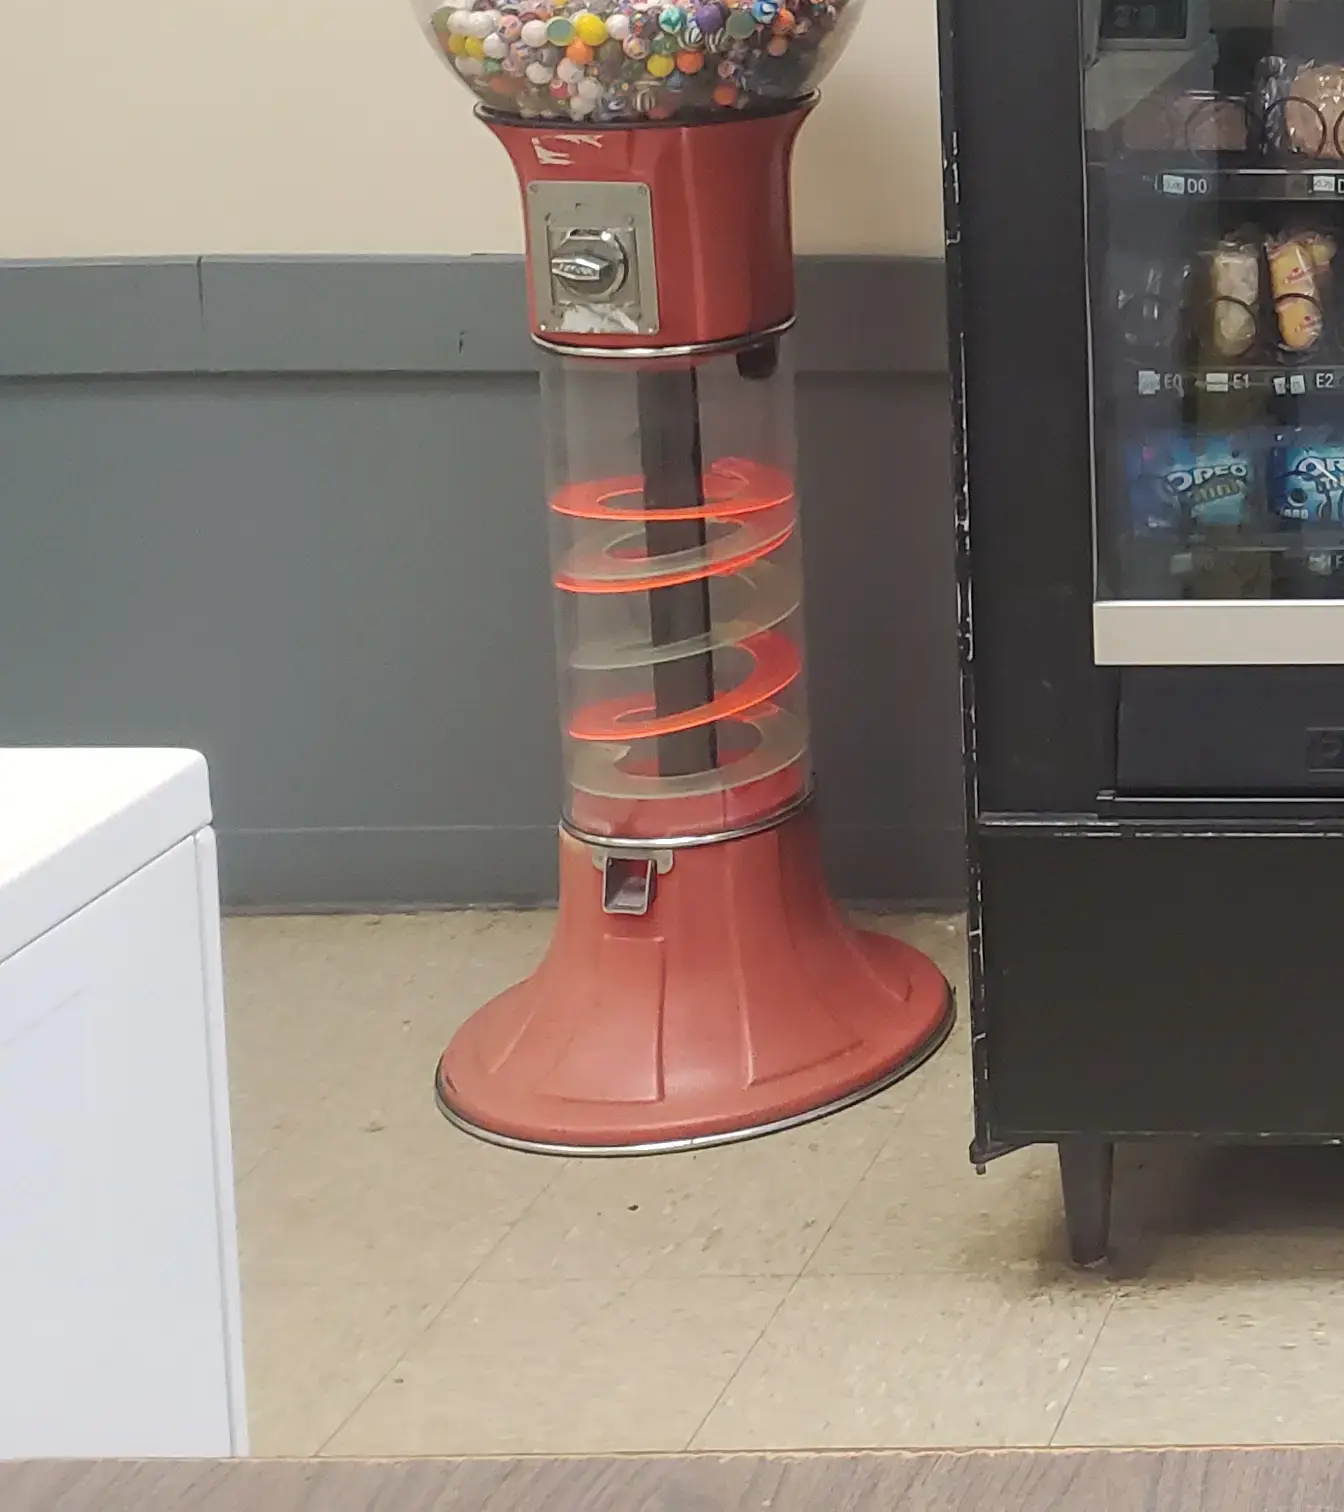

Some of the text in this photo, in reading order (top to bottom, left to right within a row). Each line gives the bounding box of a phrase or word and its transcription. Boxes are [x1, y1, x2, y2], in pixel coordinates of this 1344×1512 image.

[1187, 178, 1208, 195] D0
[1232, 373, 1250, 389] E1
[1315, 373, 1334, 388] E2
